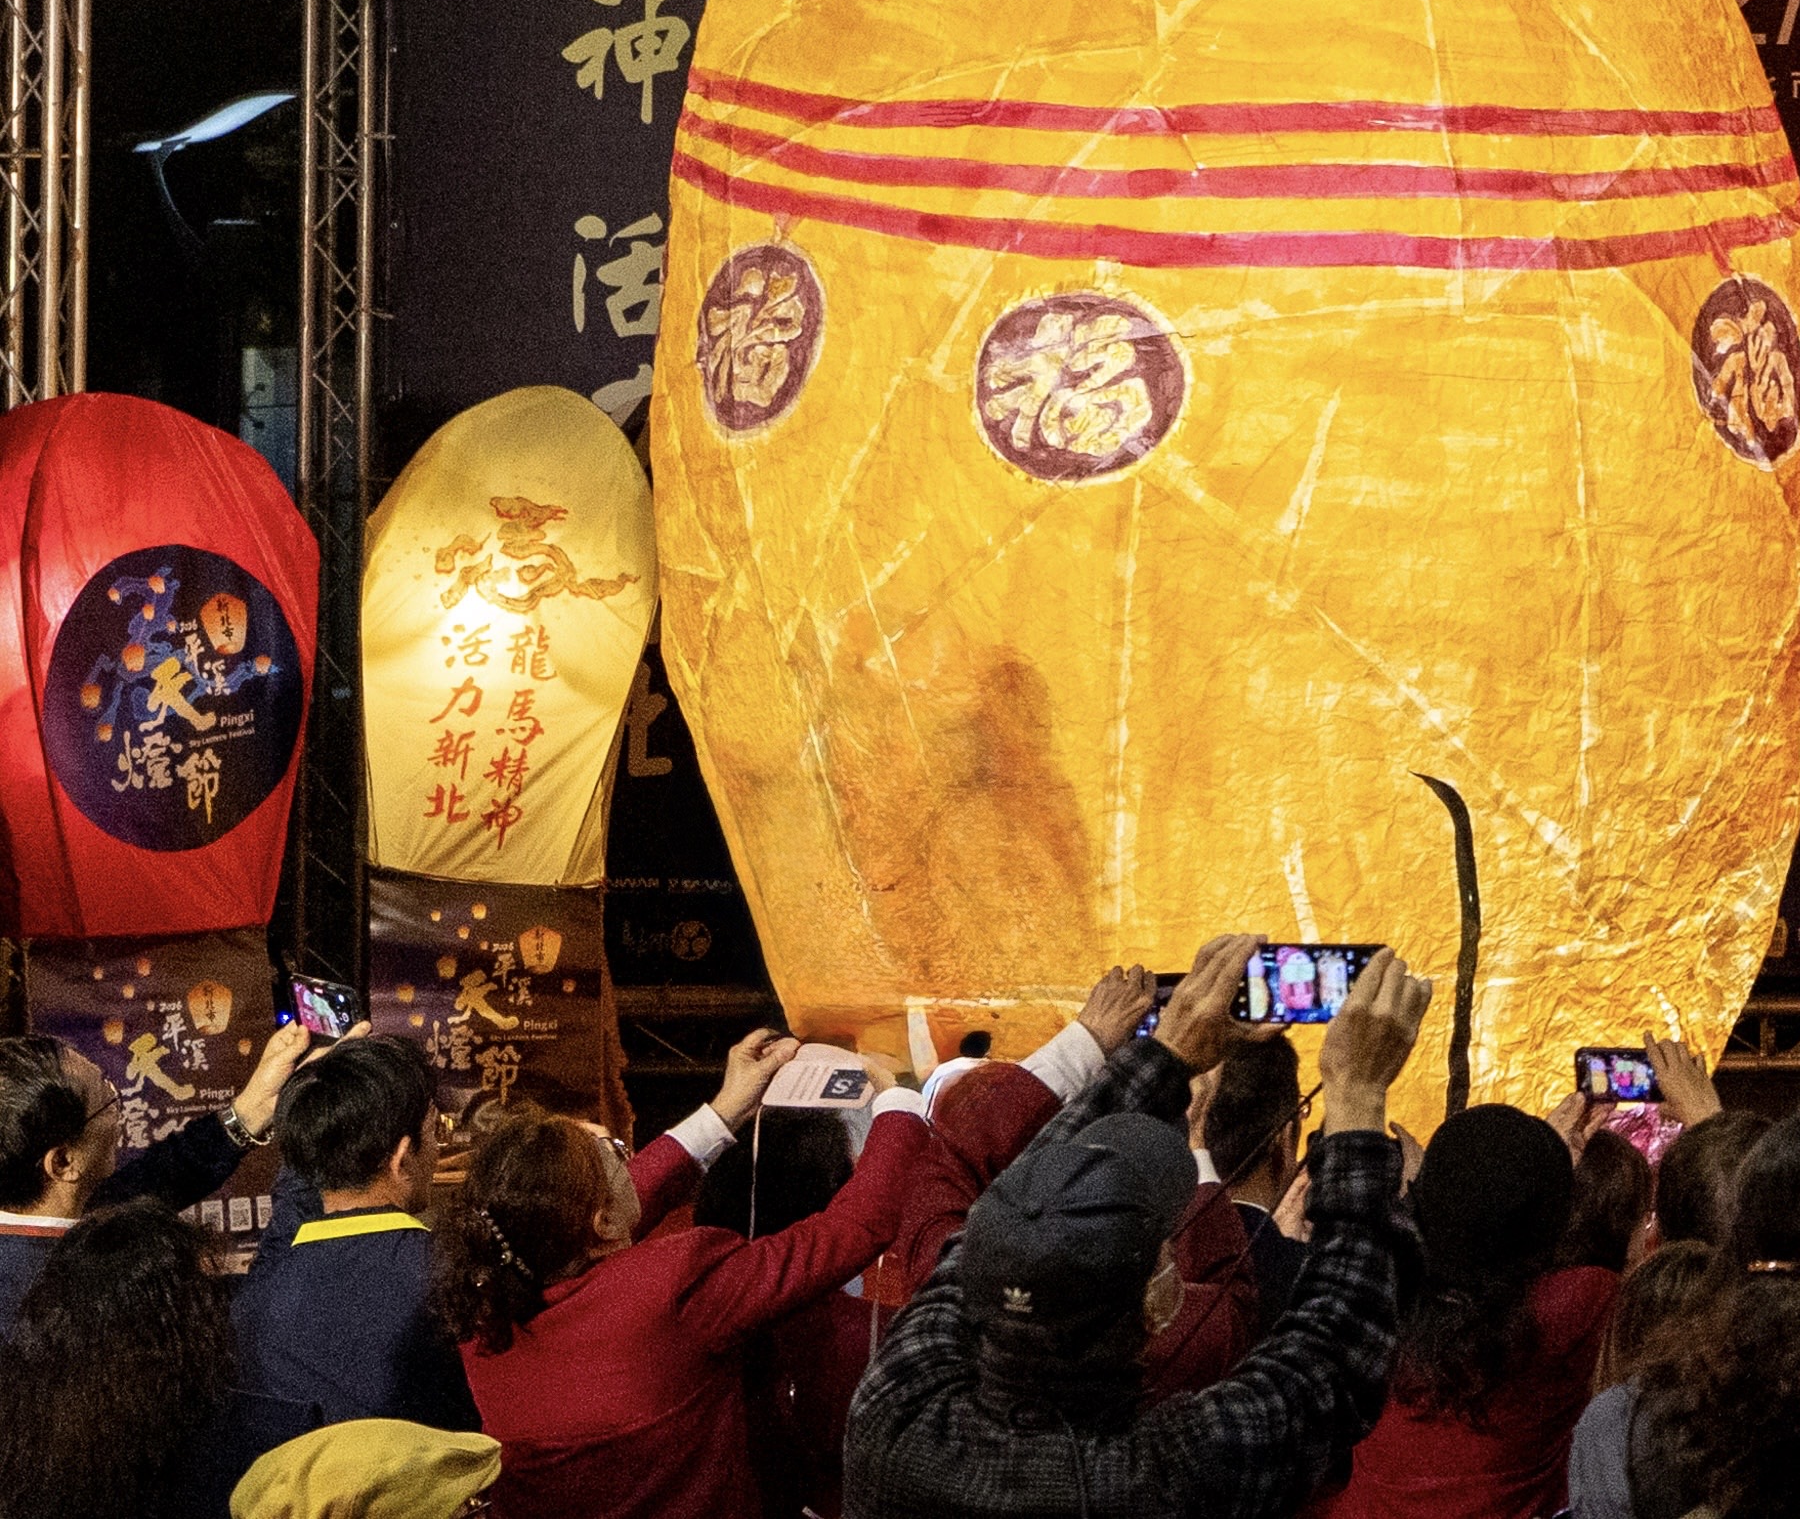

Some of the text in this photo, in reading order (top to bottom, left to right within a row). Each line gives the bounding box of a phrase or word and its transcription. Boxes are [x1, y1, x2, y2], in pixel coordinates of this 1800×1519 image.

[985, 312, 1153, 458] 福
[111, 657, 222, 825] 天燈節
[220, 709, 255, 728] Pingxi
[423, 623, 492, 825] 活力新北
[481, 624, 558, 851] 龍馬精神
[200, 1086, 235, 1100] Pingxi
[426, 970, 522, 1106] 天燈節
